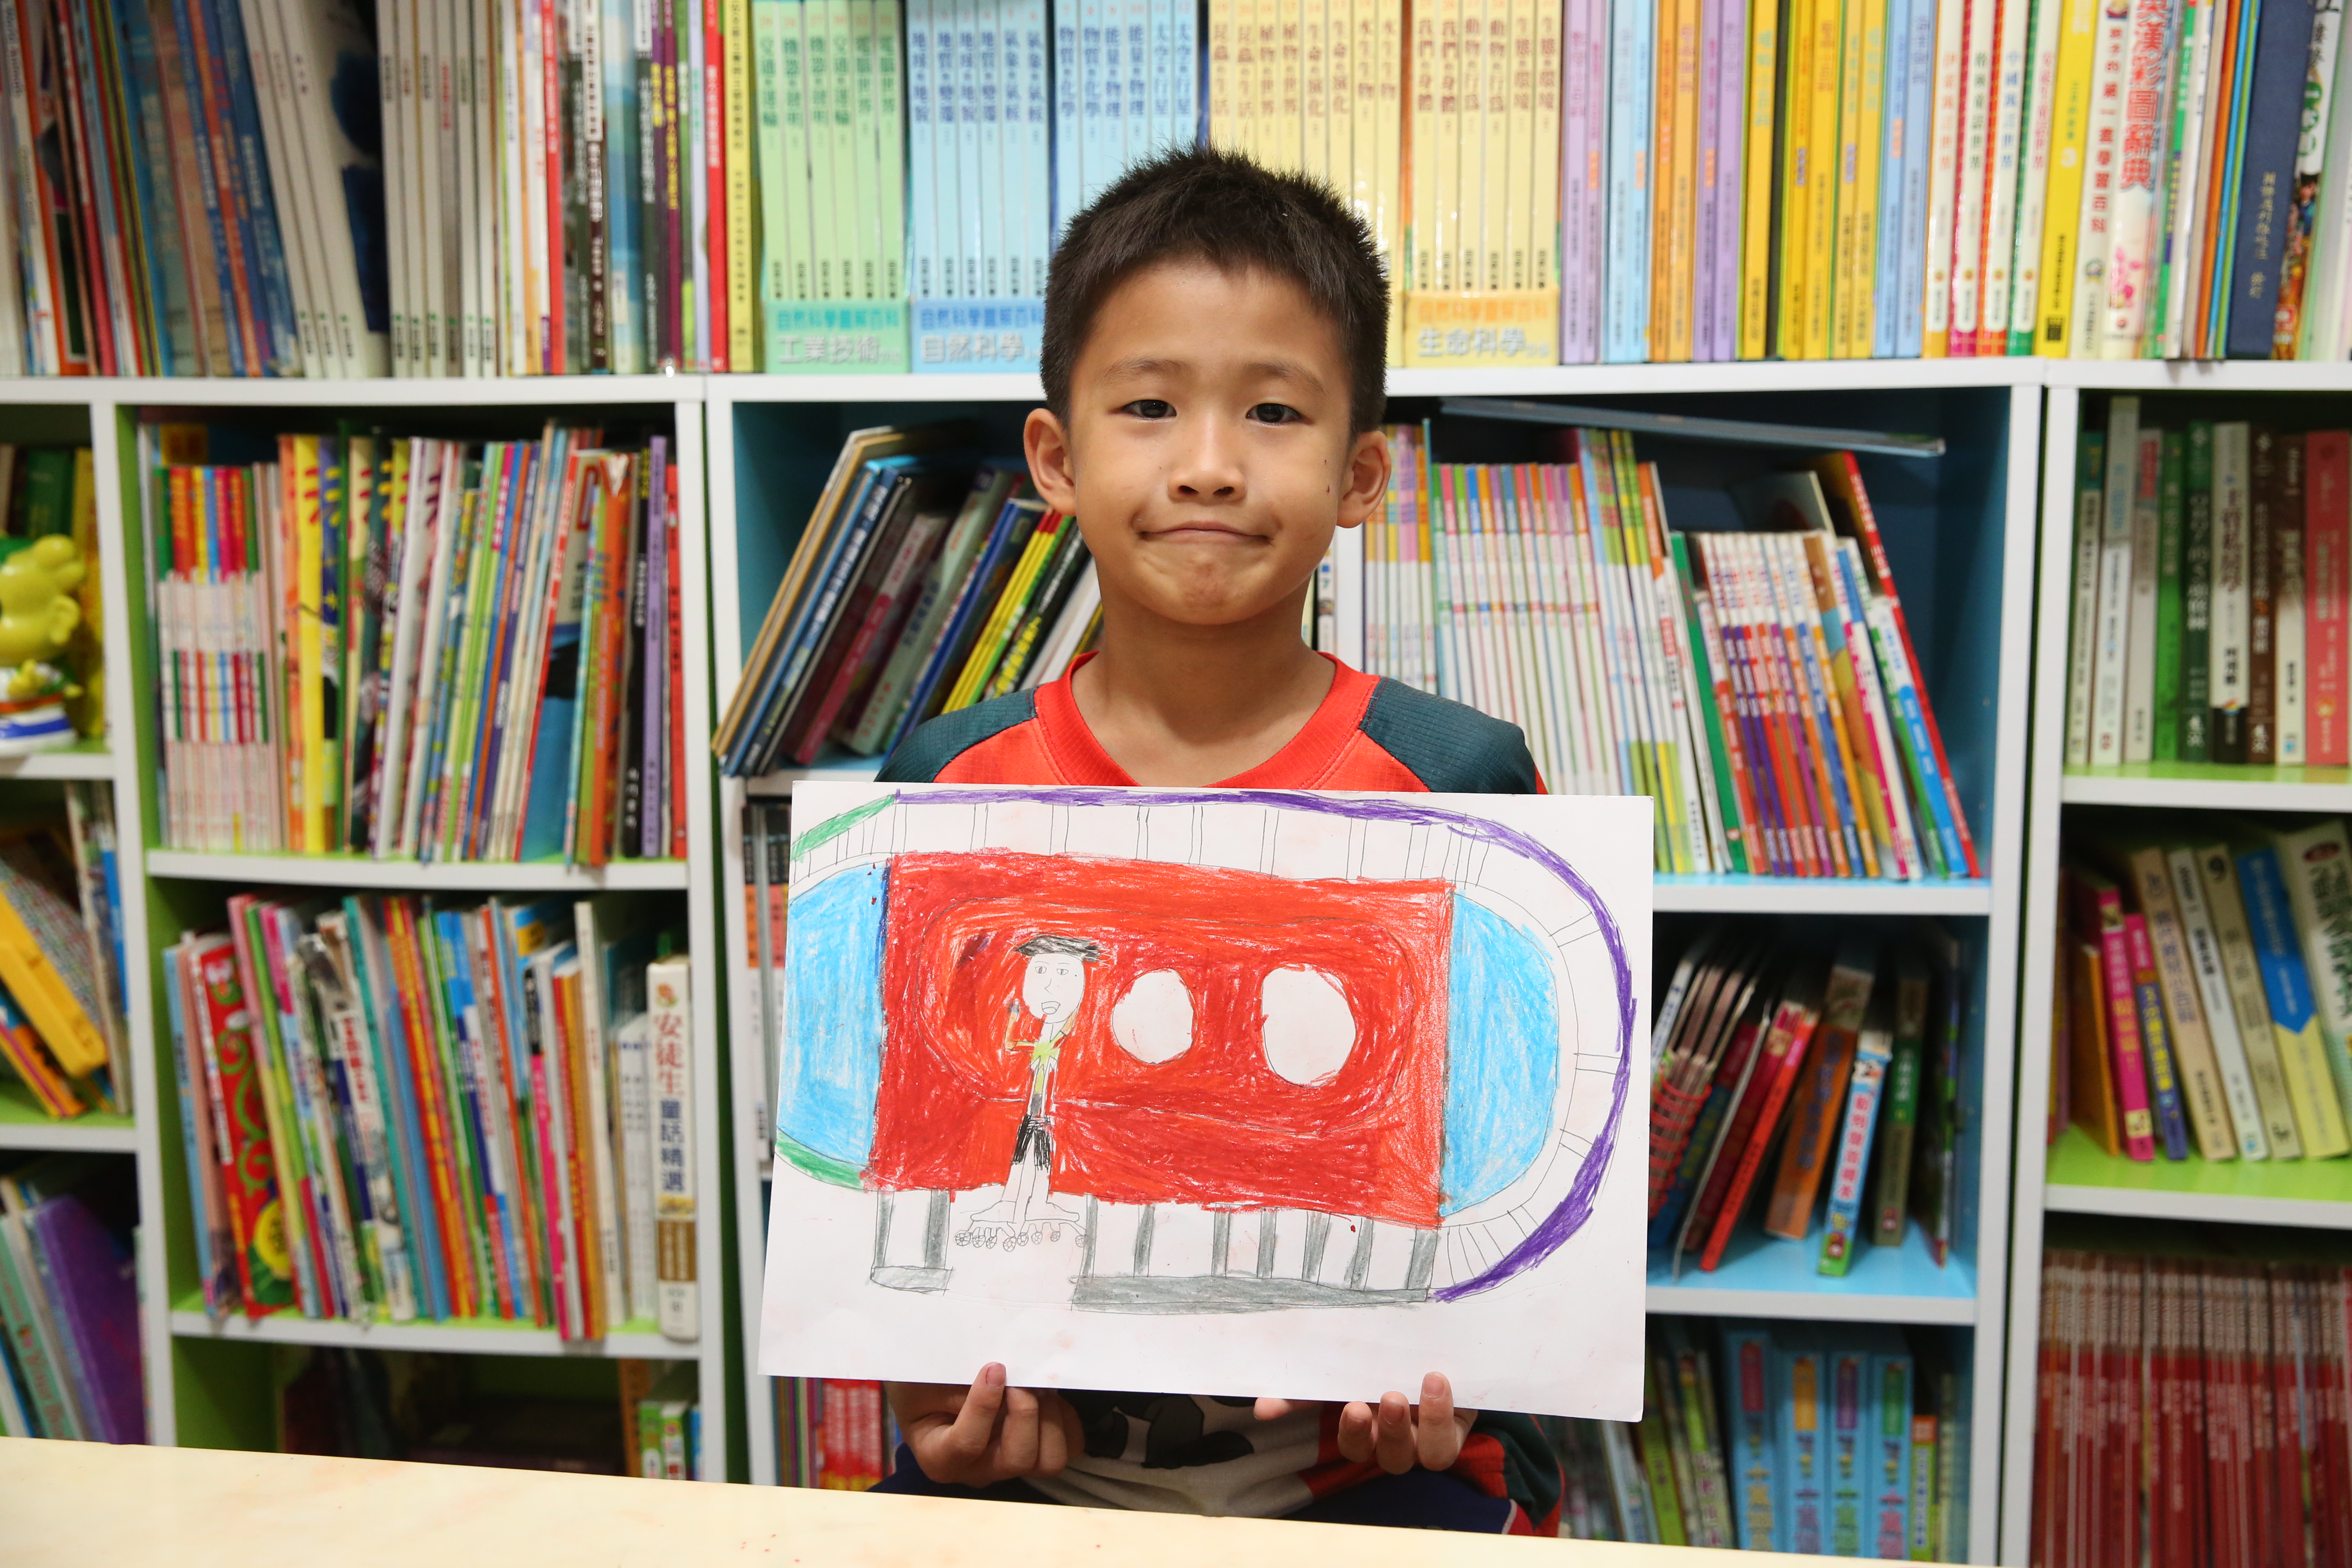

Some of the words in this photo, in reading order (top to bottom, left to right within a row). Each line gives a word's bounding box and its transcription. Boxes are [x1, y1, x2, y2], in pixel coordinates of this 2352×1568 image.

[776, 335, 880, 365] 工業技術
[920, 332, 1022, 365] 自然科學
[1418, 326, 1526, 358] 生命科學
[653, 1013, 685, 1192] 安徒生童話精選
